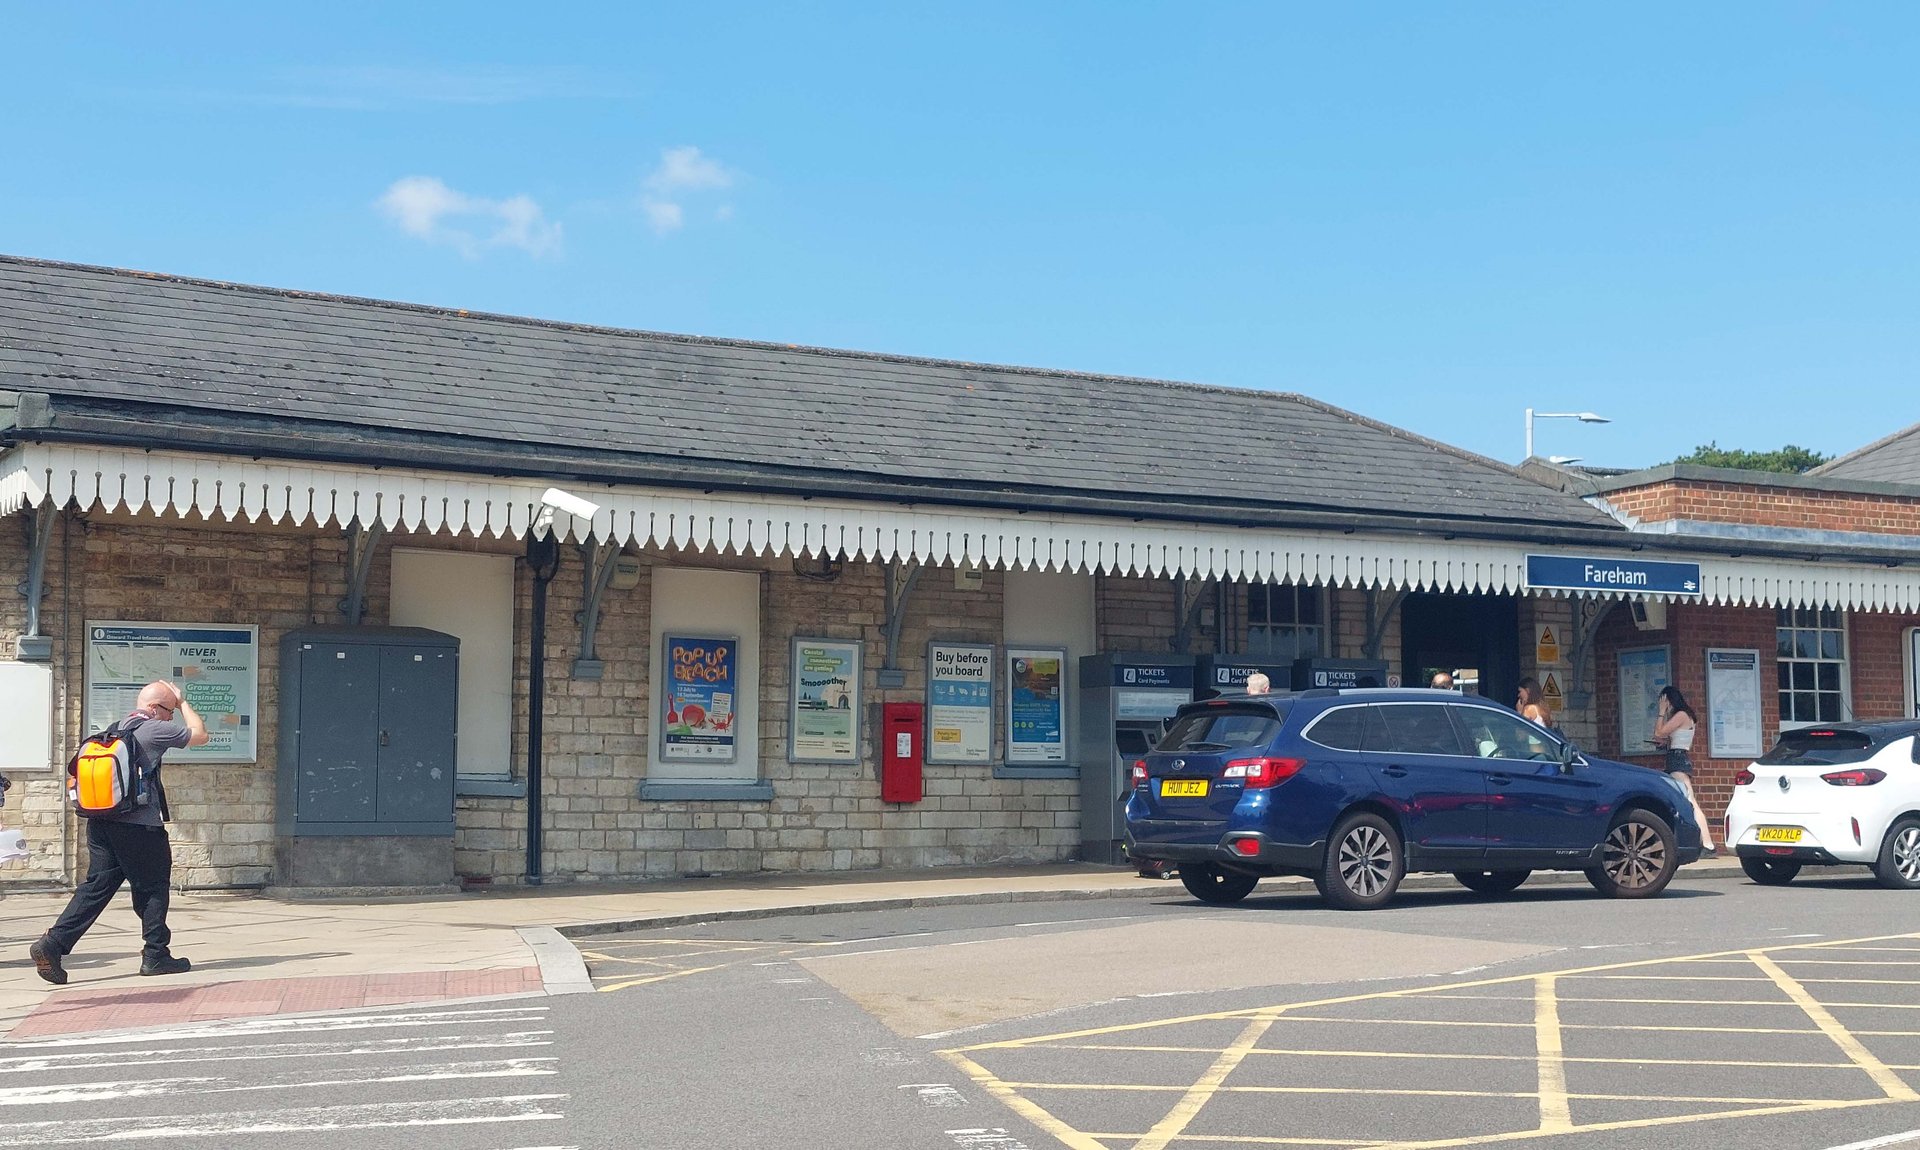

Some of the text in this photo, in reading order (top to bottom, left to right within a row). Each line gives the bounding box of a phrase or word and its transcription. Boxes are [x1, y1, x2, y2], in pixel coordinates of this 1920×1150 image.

[1585, 564, 1647, 585] Fareham
[179, 647, 217, 657] NEVER
[673, 646, 727, 667] POP UP
[936, 651, 988, 665] Buy before
[674, 662, 728, 682] BEACH
[935, 665, 983, 677] you board
[1138, 668, 1165, 676] TICKETS
[1328, 671, 1356, 680] TICKETS
[187, 683, 231, 693] Grow your
[224, 694, 235, 702] by
[1167, 782, 1200, 793] HU11 JEZ
[1762, 829, 1802, 840] VK20 XLP
